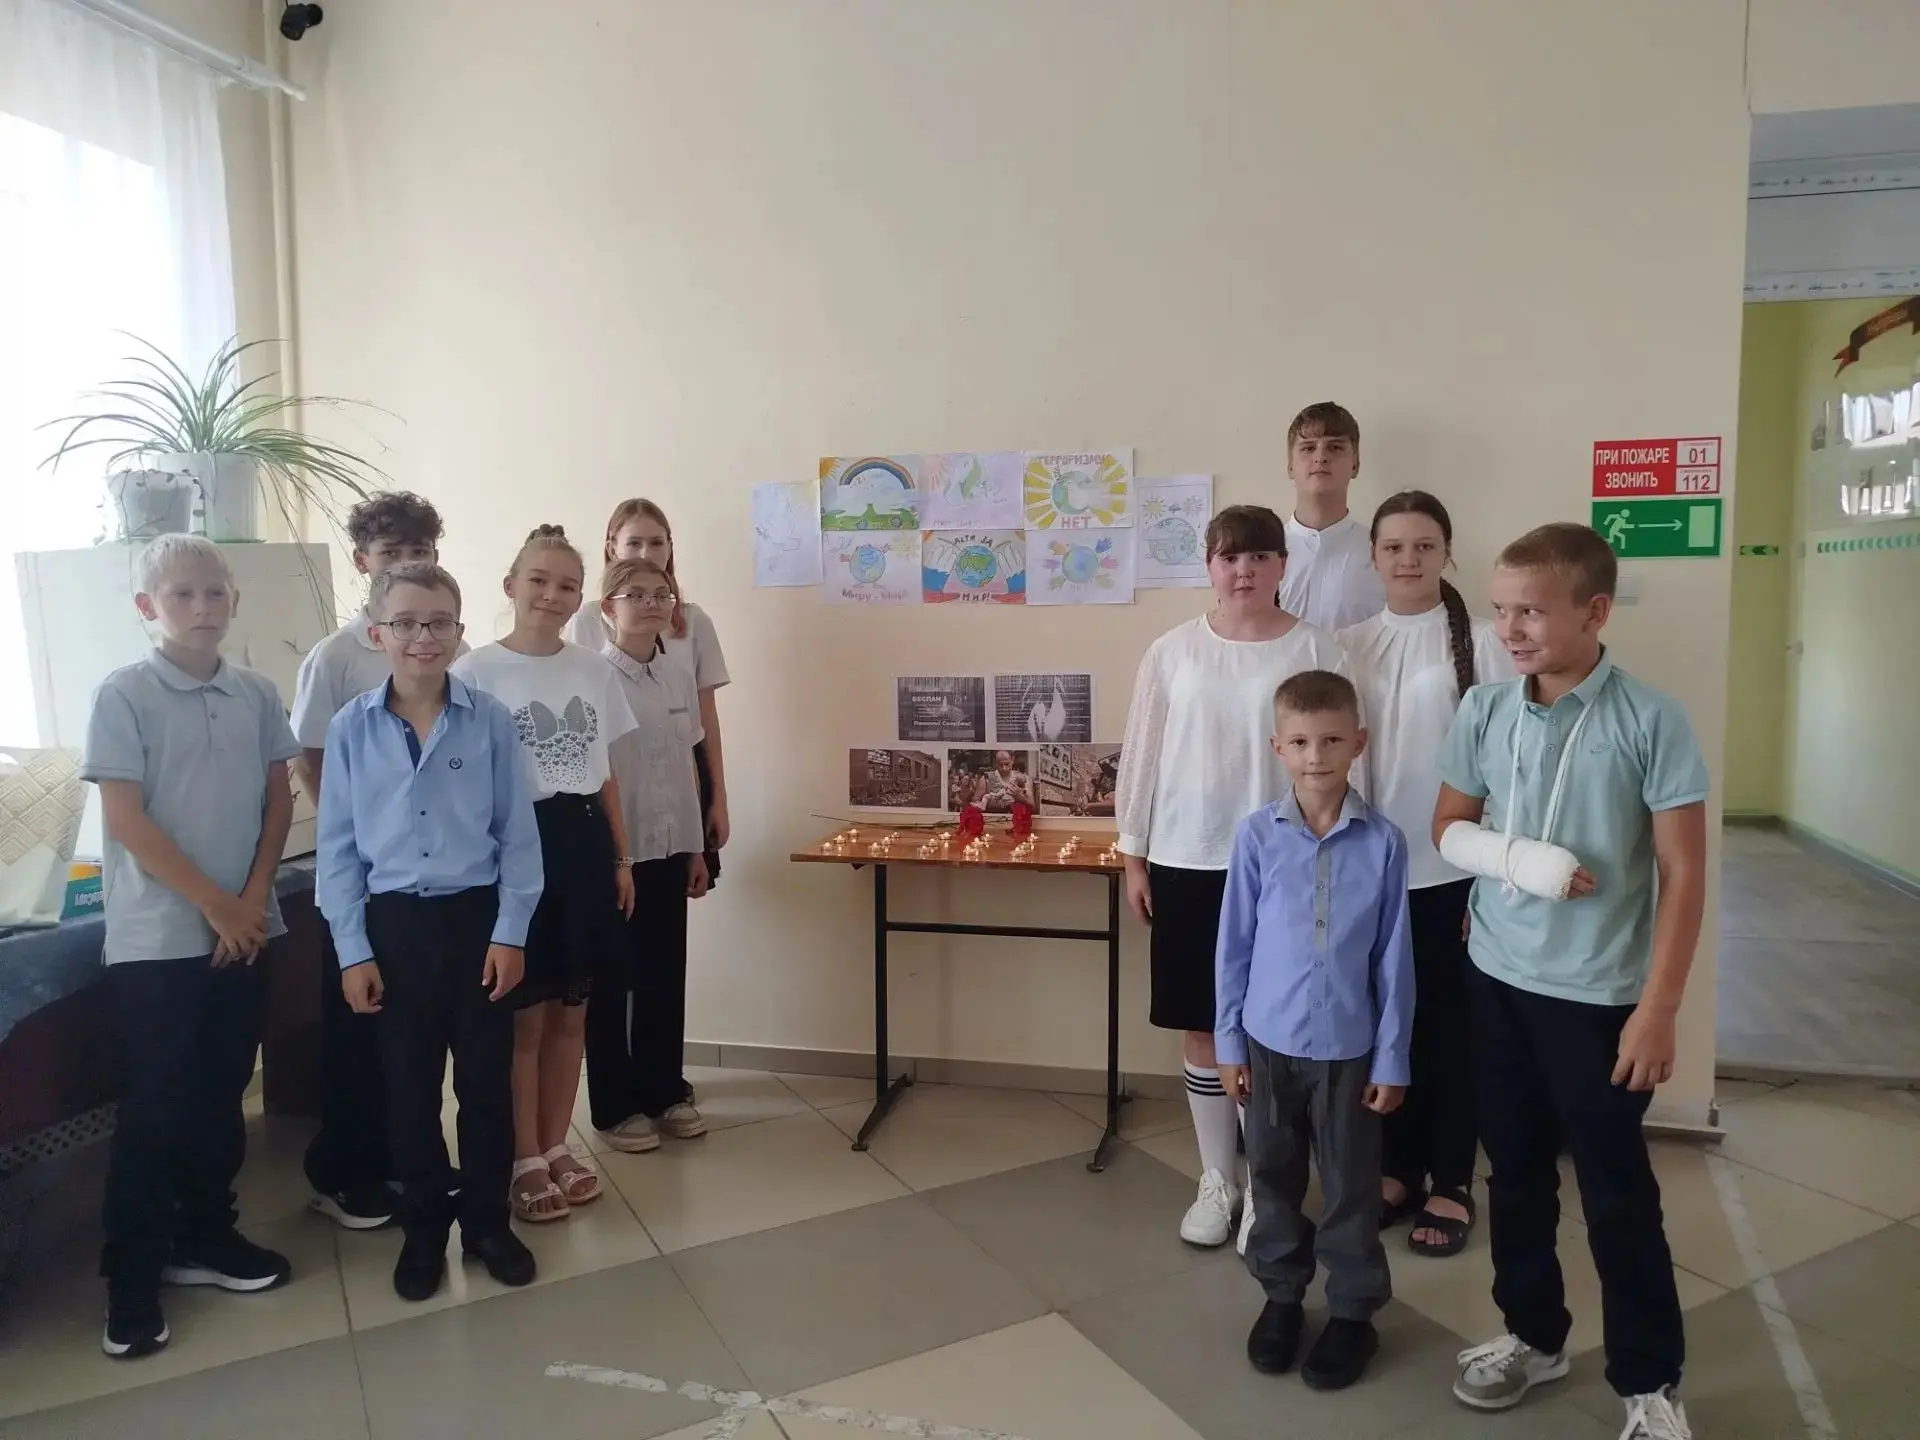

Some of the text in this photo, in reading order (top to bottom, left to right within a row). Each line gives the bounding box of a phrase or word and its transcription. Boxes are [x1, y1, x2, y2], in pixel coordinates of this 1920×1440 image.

[1595, 448, 1670, 465] ПРИ ПОЖАРЕ
[1688, 447, 1707, 463] 01
[1605, 471, 1658, 488] ЗВОНИТЬ
[1682, 474, 1711, 491] 112
[1060, 516, 1091, 529] НЕТ
